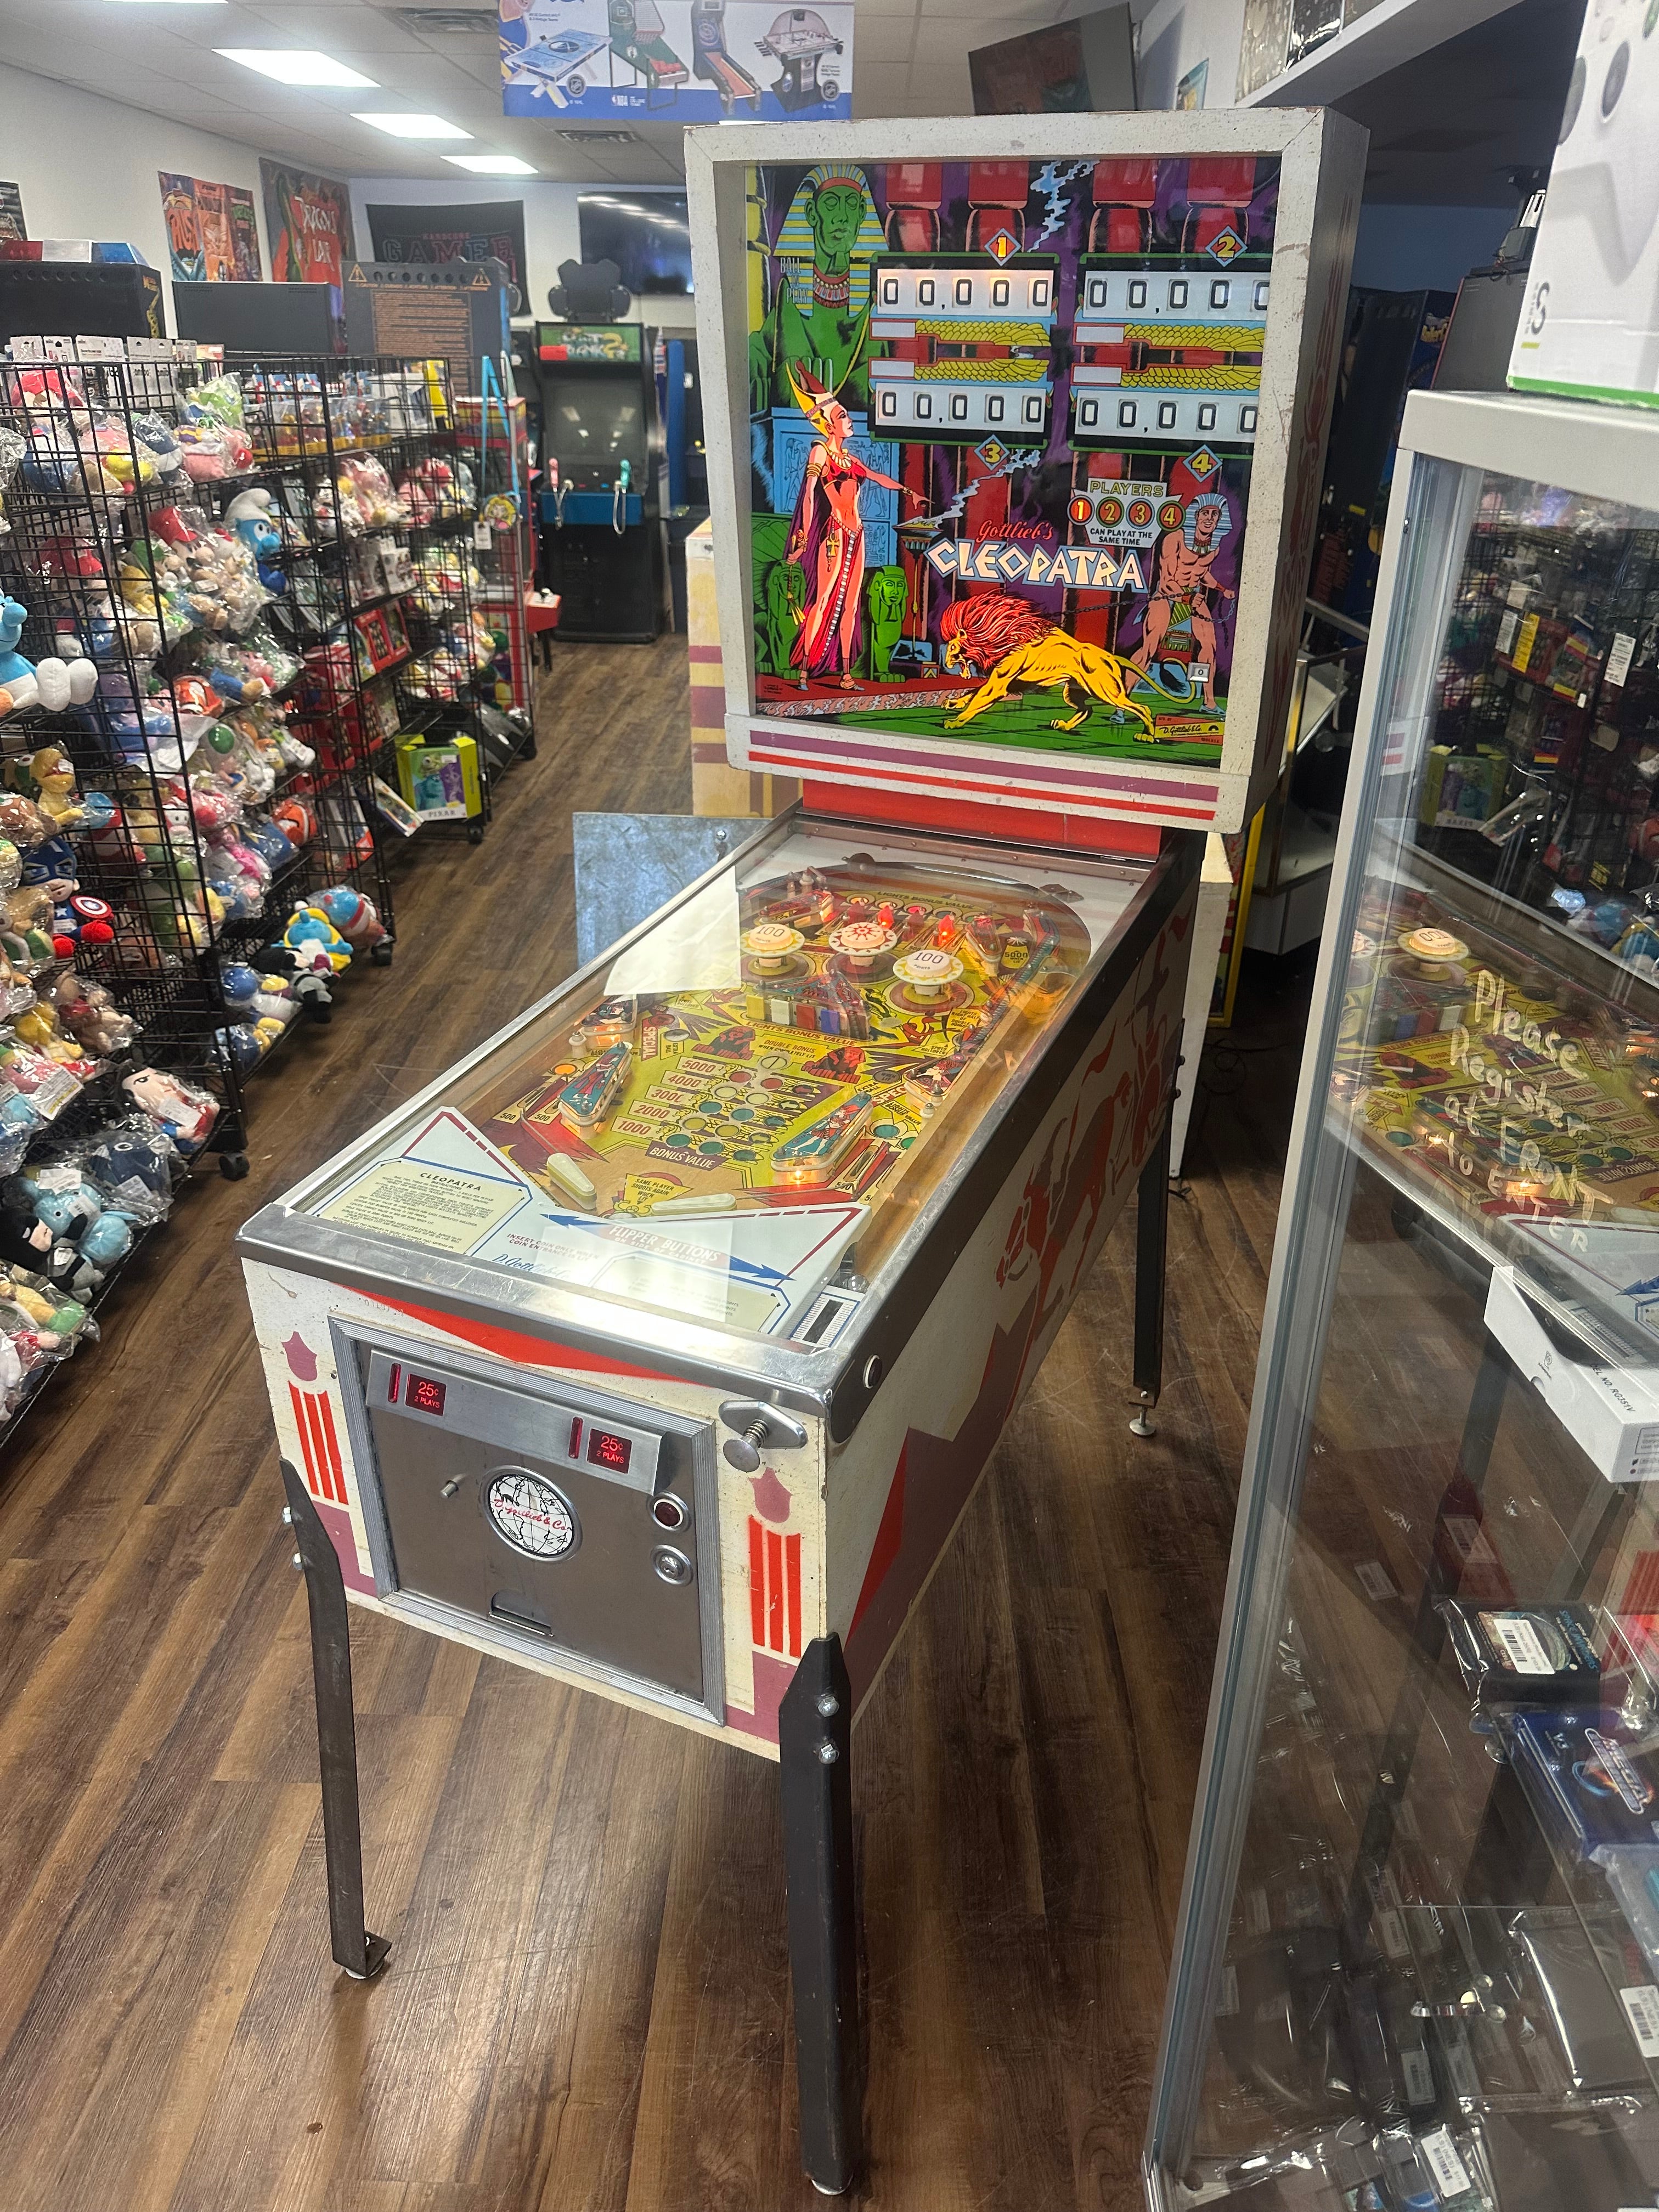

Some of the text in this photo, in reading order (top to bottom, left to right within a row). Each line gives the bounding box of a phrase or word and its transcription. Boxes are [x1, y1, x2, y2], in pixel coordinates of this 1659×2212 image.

[996, 236, 1007, 258] 1
[1216, 236, 1237, 259] 2
[780, 257, 801, 274] BALL
[787, 287, 809, 304] PLAY
[984, 443, 1002, 464] 3
[1191, 453, 1213, 473] 4
[1090, 481, 1164, 498] PLAYERS
[1077, 500, 1176, 526] 1 2 3 4
[976, 520, 1053, 543] Gottlieb's
[1098, 536, 1140, 545] SAME TIME
[924, 538, 1148, 593] CLEOPATRA
[877, 891, 974, 909] LIGHTS BONUS VALUE
[756, 926, 785, 937] 100
[913, 952, 944, 964] 100
[746, 1021, 857, 1046] LIGHTS BONUS VALUE
[1475, 969, 1590, 1081] Please
[643, 1026, 657, 1058] SPECIAL
[764, 1039, 816, 1053] DOUBLE BONUS
[682, 1060, 716, 1073] 5000
[668, 1076, 702, 1088] 4000
[857, 1082, 879, 1092] EXTRA
[500, 1112, 517, 1120] 500
[534, 1114, 550, 1122] 500
[634, 1104, 670, 1119] 2000
[618, 1121, 652, 1135] 1000
[650, 1147, 715, 1169] BONUS VALUE
[1444, 1092, 1615, 1224] at FRONT
[420, 1173, 482, 1191] CLEOPATRA
[430, 1180, 462, 1190] INSTRUCTIONS
[631, 1183, 652, 1192] SHOOTS
[652, 1182, 675, 1191] PLAYER
[1488, 1168, 1588, 1252] ENTER
[507, 1233, 535, 1244] INSERT
[535, 1240, 554, 1249] COIN
[609, 1225, 721, 1261] FLIPPER BUTTONS
[630, 1241, 650, 1250] SIDE
[529, 1244, 567, 1257] ENTRANCE
[418, 1380, 439, 1398] 25¢
[420, 1396, 440, 1409] PLAYS
[1610, 1388, 1636, 1413] RG351V
[600, 1435, 624, 1452] 25¢
[602, 1452, 624, 1464] PLAYS
[543, 1516, 550, 1525] &
[552, 1520, 569, 1531] Co.
